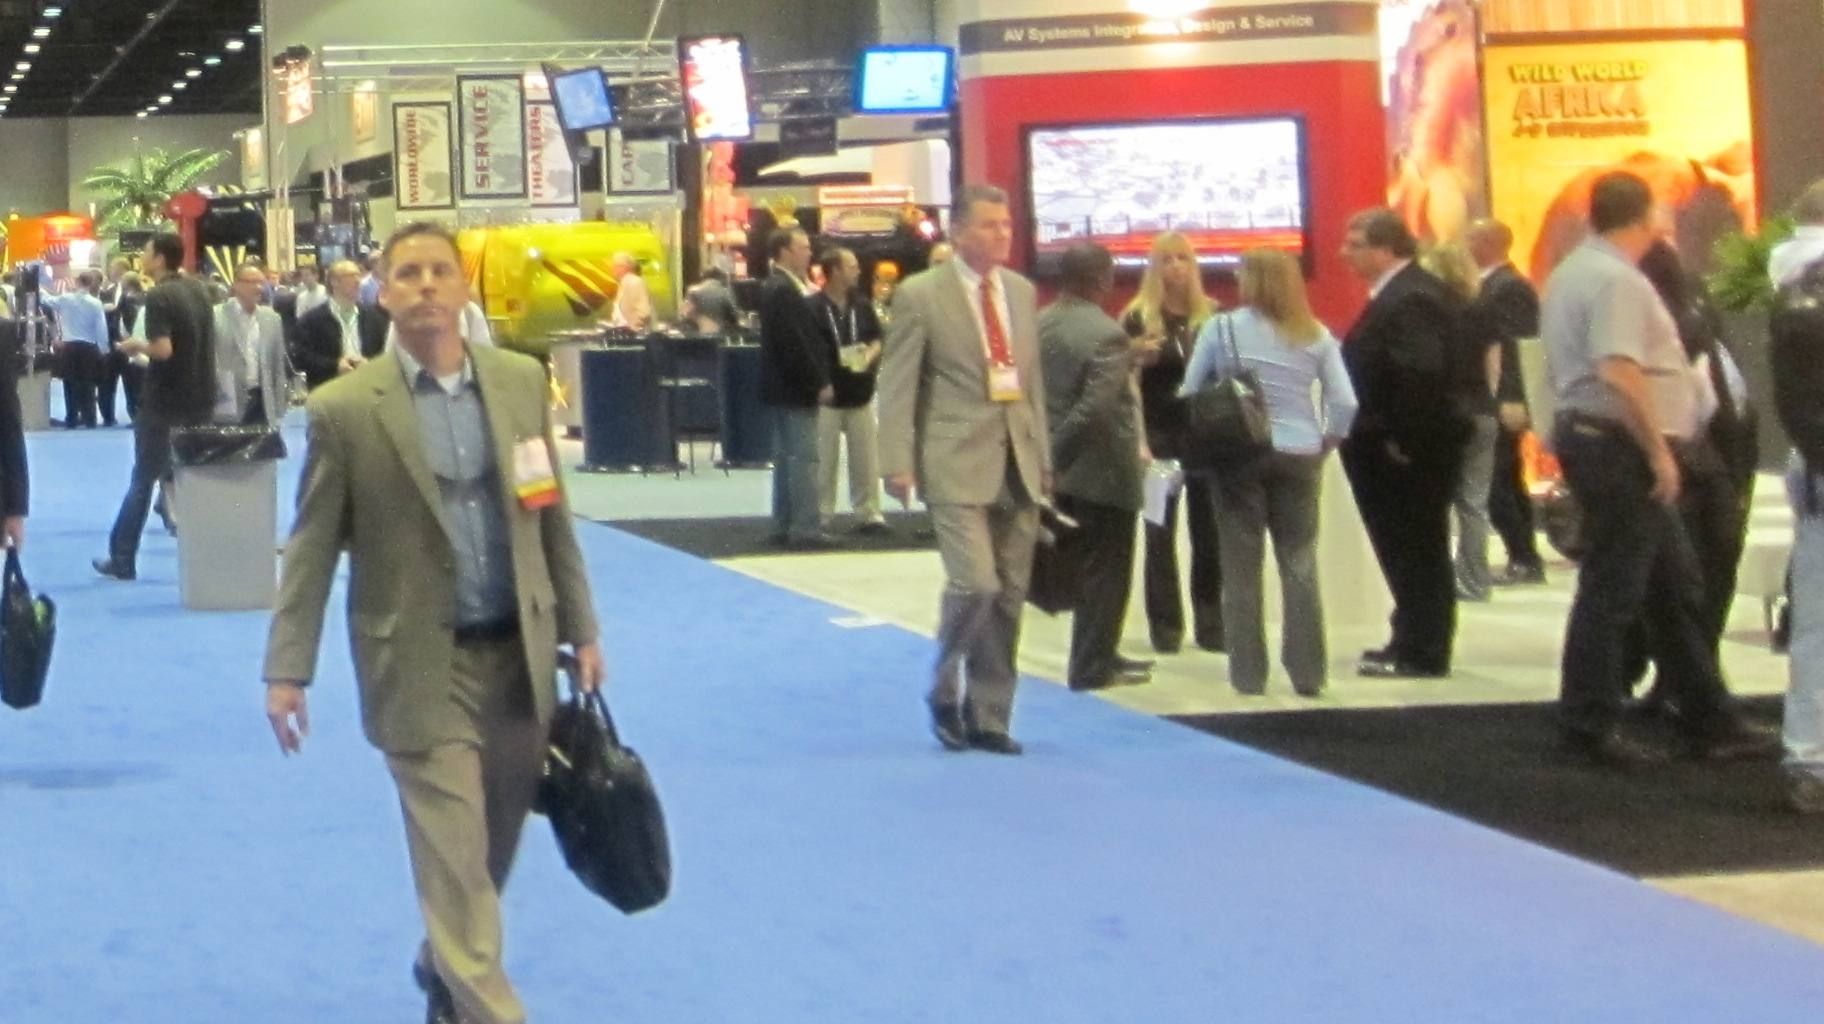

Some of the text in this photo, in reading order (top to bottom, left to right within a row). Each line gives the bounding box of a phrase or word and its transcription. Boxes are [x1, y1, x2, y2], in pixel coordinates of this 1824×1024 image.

[1004, 29, 1024, 43] AV
[1028, 27, 1091, 44] Systems
[1239, 16, 1251, 30] &
[1255, 13, 1314, 30] Service
[1508, 60, 1648, 83] WILD WORLD
[473, 85, 490, 190] SERVICE
